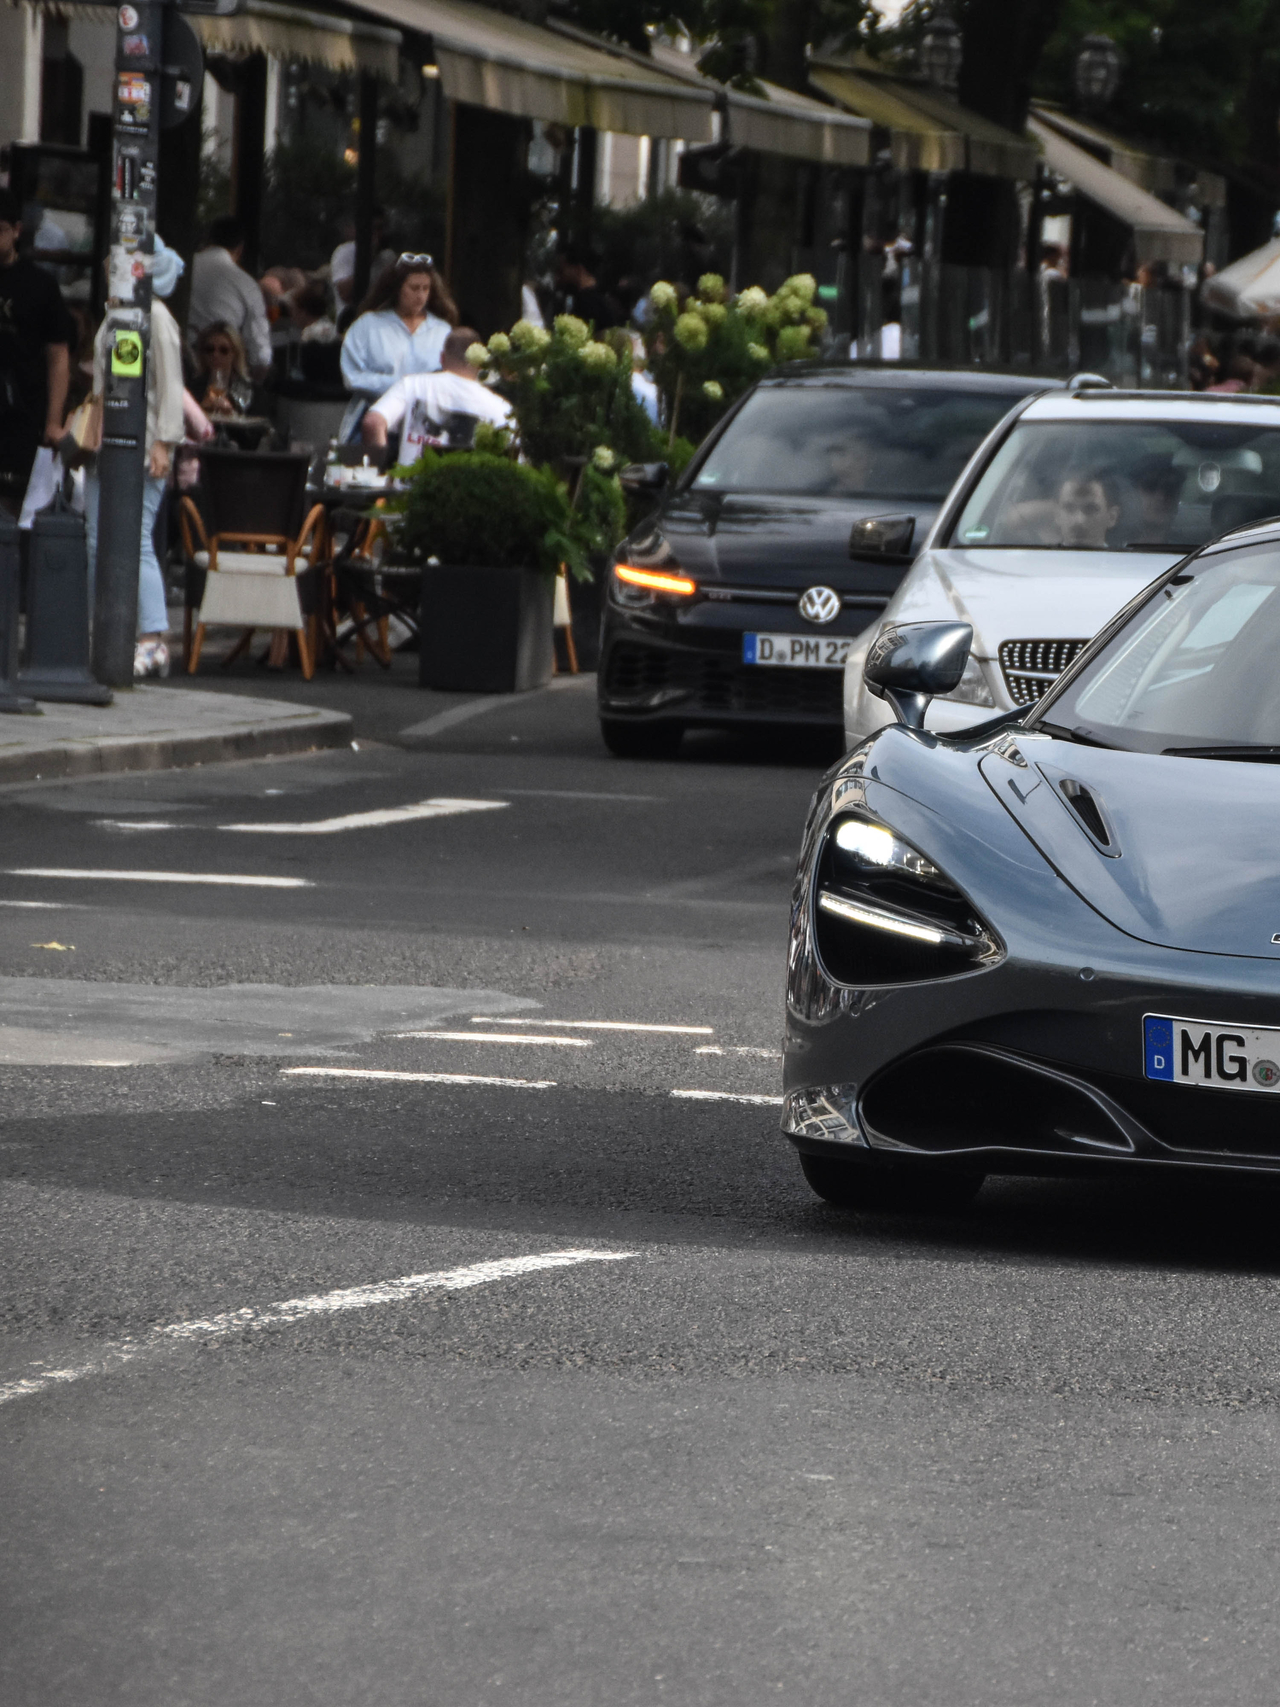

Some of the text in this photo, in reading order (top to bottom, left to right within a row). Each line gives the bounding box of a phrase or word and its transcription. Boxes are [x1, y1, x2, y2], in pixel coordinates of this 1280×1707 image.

[758, 638, 774, 660] D
[790, 639, 820, 663] PM
[1154, 1055, 1165, 1069] D
[1180, 1027, 1248, 1082] MG
